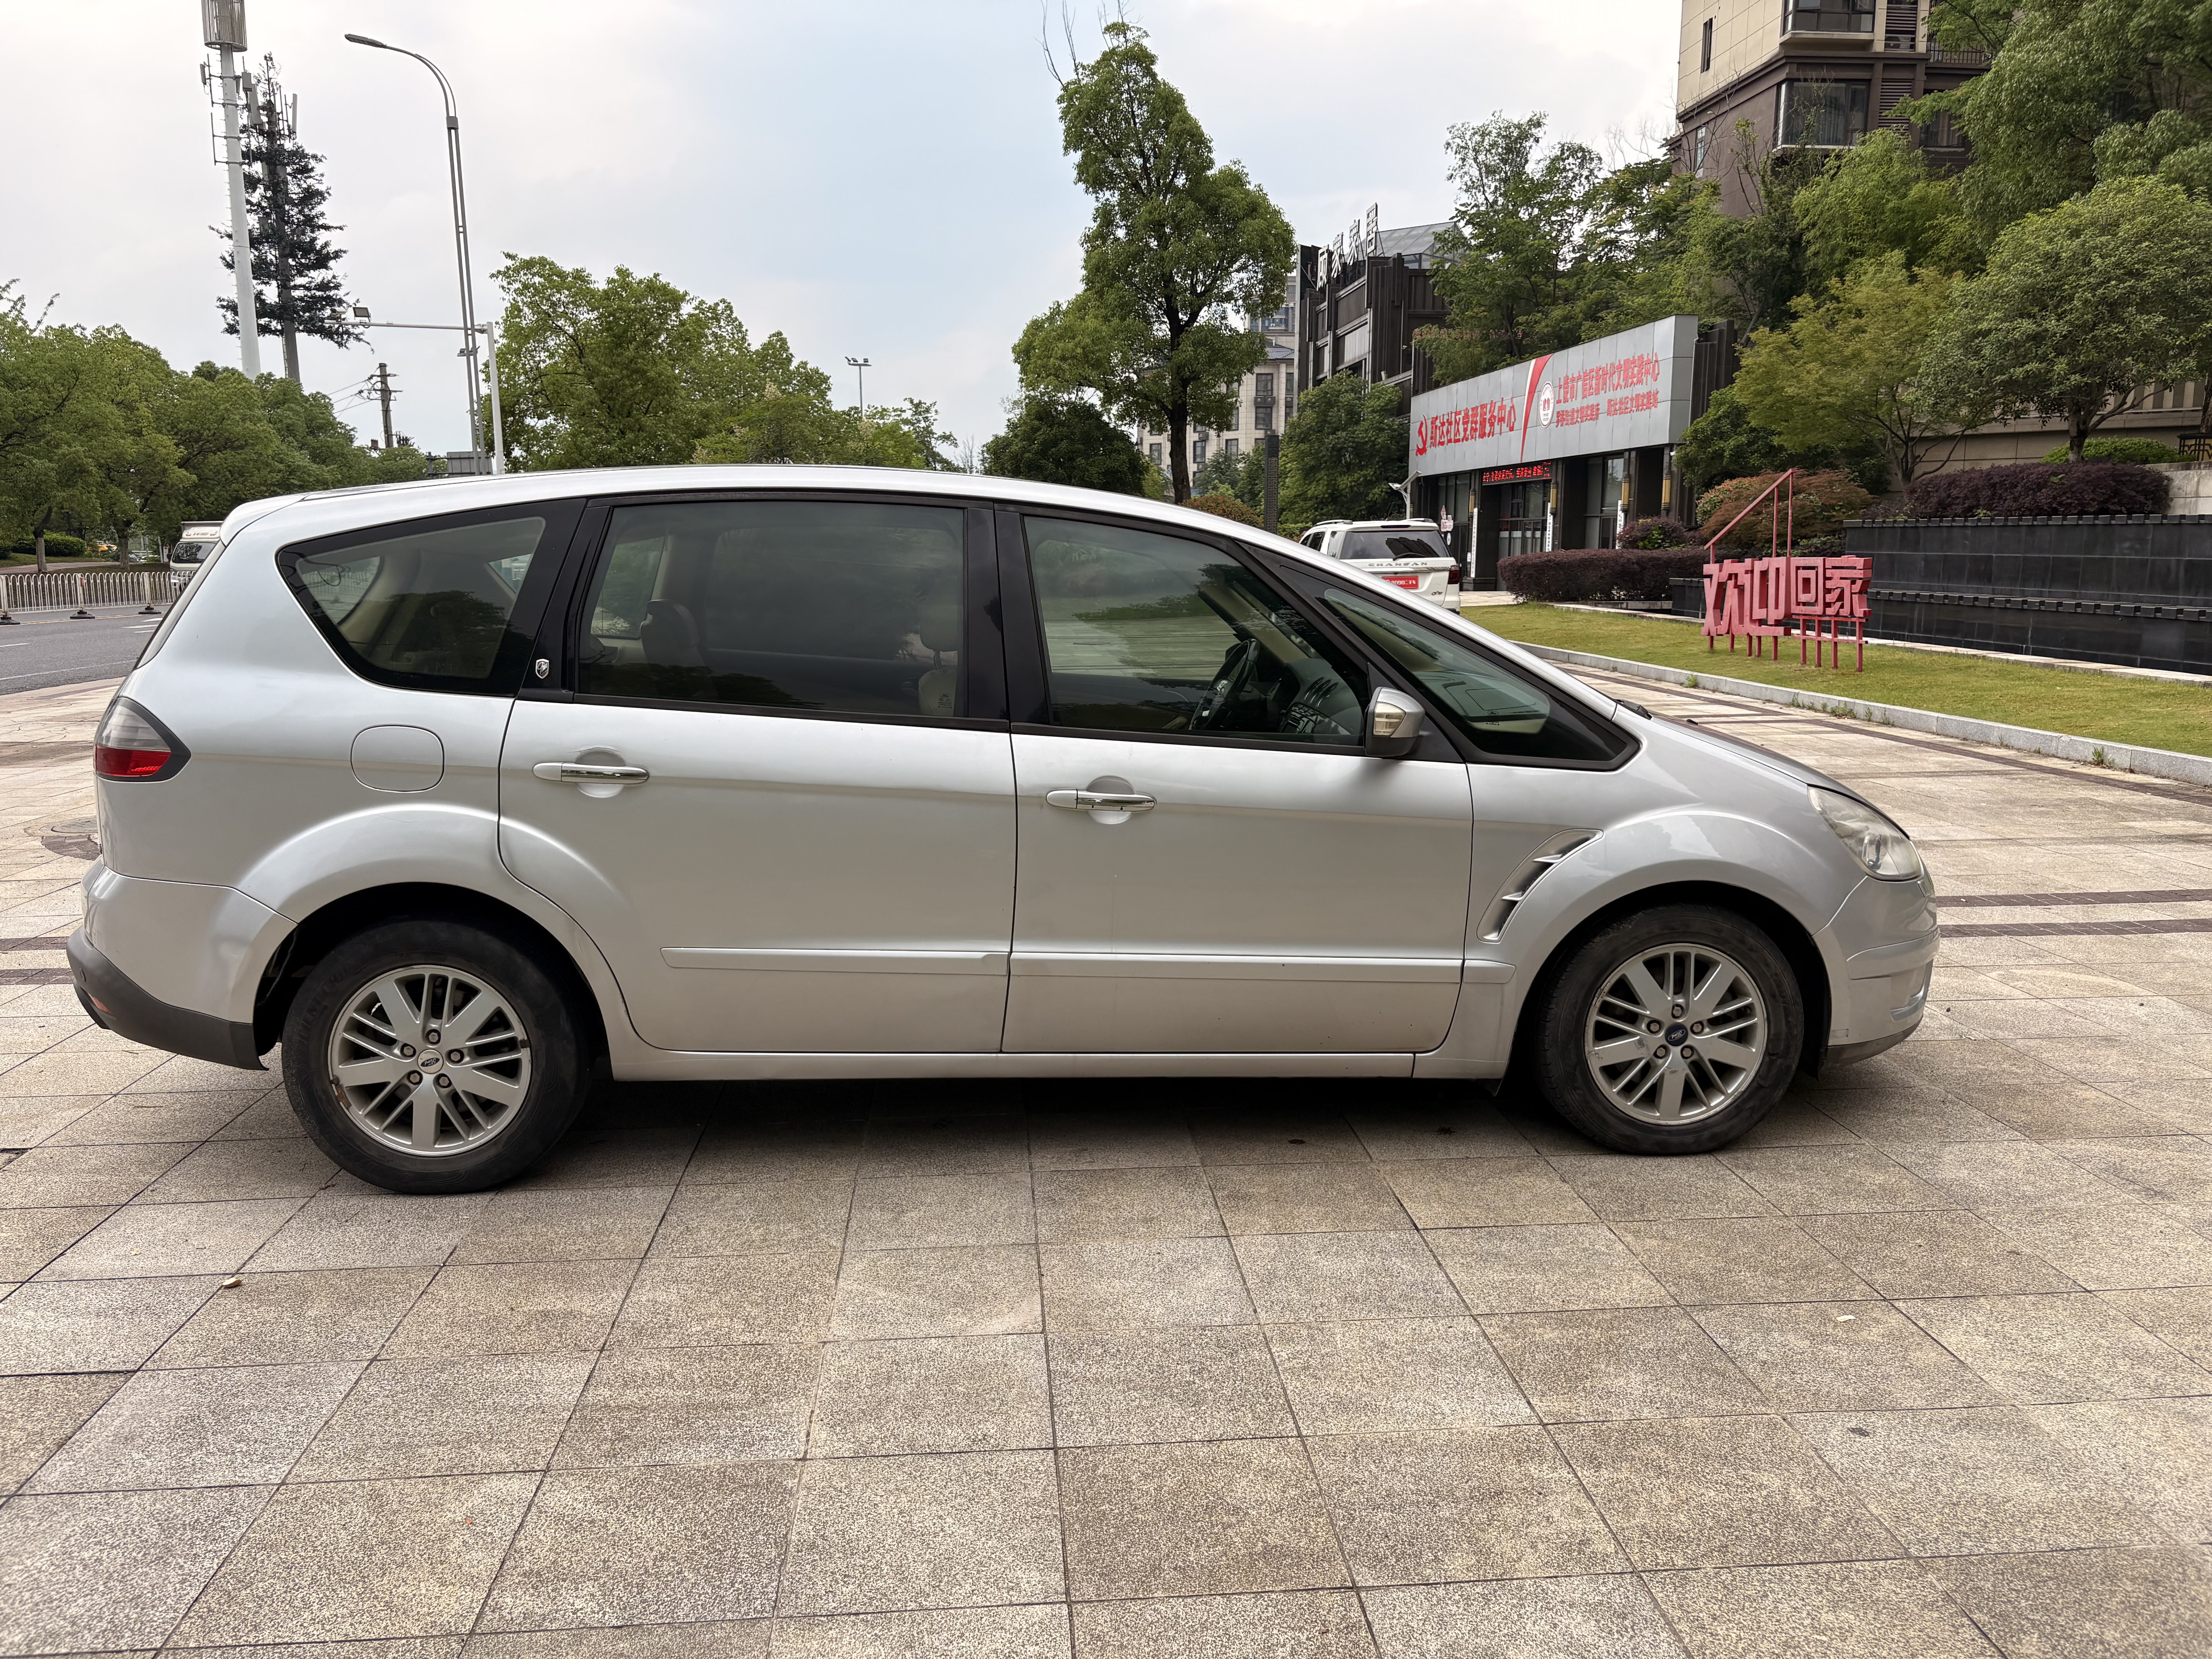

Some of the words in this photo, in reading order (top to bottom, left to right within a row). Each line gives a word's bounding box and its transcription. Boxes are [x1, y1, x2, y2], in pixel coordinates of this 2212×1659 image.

[1316, 202, 1378, 291] 顾家家居
[1701, 555, 1873, 637] 欢迎回家
[424, 1058, 437, 1066] Ford
